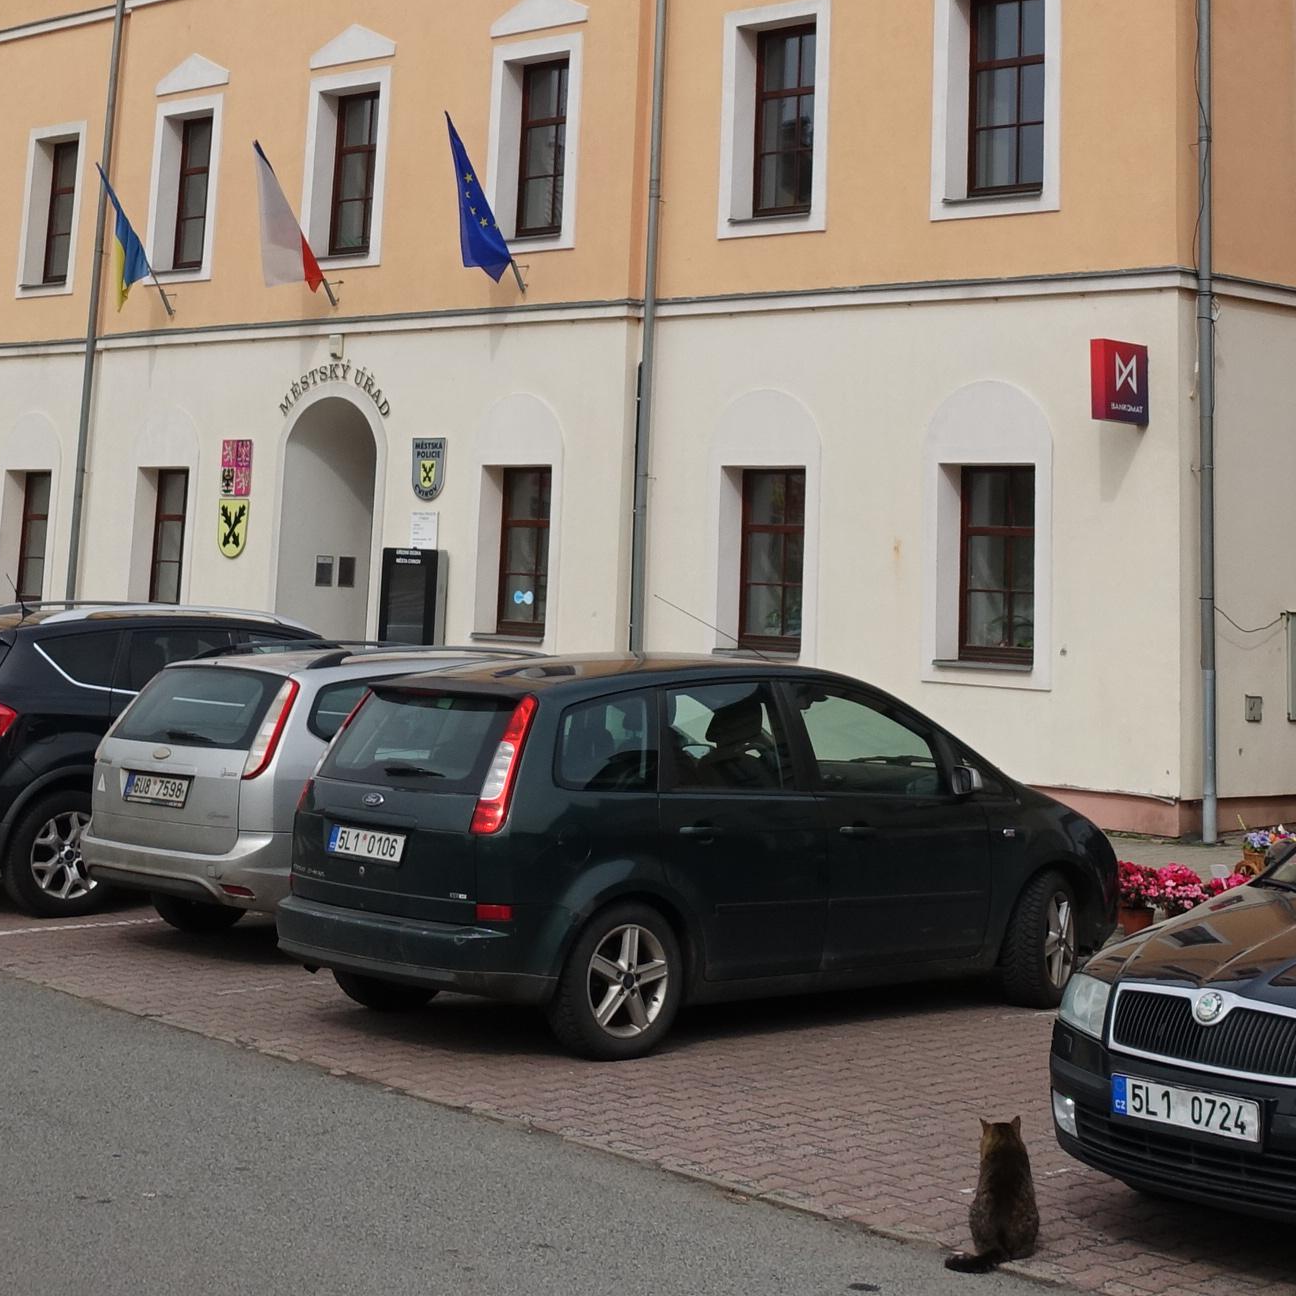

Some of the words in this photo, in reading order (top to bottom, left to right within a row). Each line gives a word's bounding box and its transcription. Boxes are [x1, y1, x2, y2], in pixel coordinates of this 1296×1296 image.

[278, 359, 351, 417] MĚSTSKÝ
[354, 366, 391, 418] ÚŘAD
[1111, 402, 1143, 413] BANKOMAT
[415, 440, 443, 450] MĚSTSKÁ
[416, 450, 441, 459] POLICIE
[414, 484, 438, 497] CVIKOV
[133, 776, 152, 795] 6U8
[155, 779, 183, 799] 7598
[338, 830, 360, 853] 5L1
[367, 835, 398, 858] 0106
[1115, 1099, 1126, 1110] CZ
[1131, 1084, 1171, 1119] 5L1
[1191, 1096, 1247, 1135] 0724
